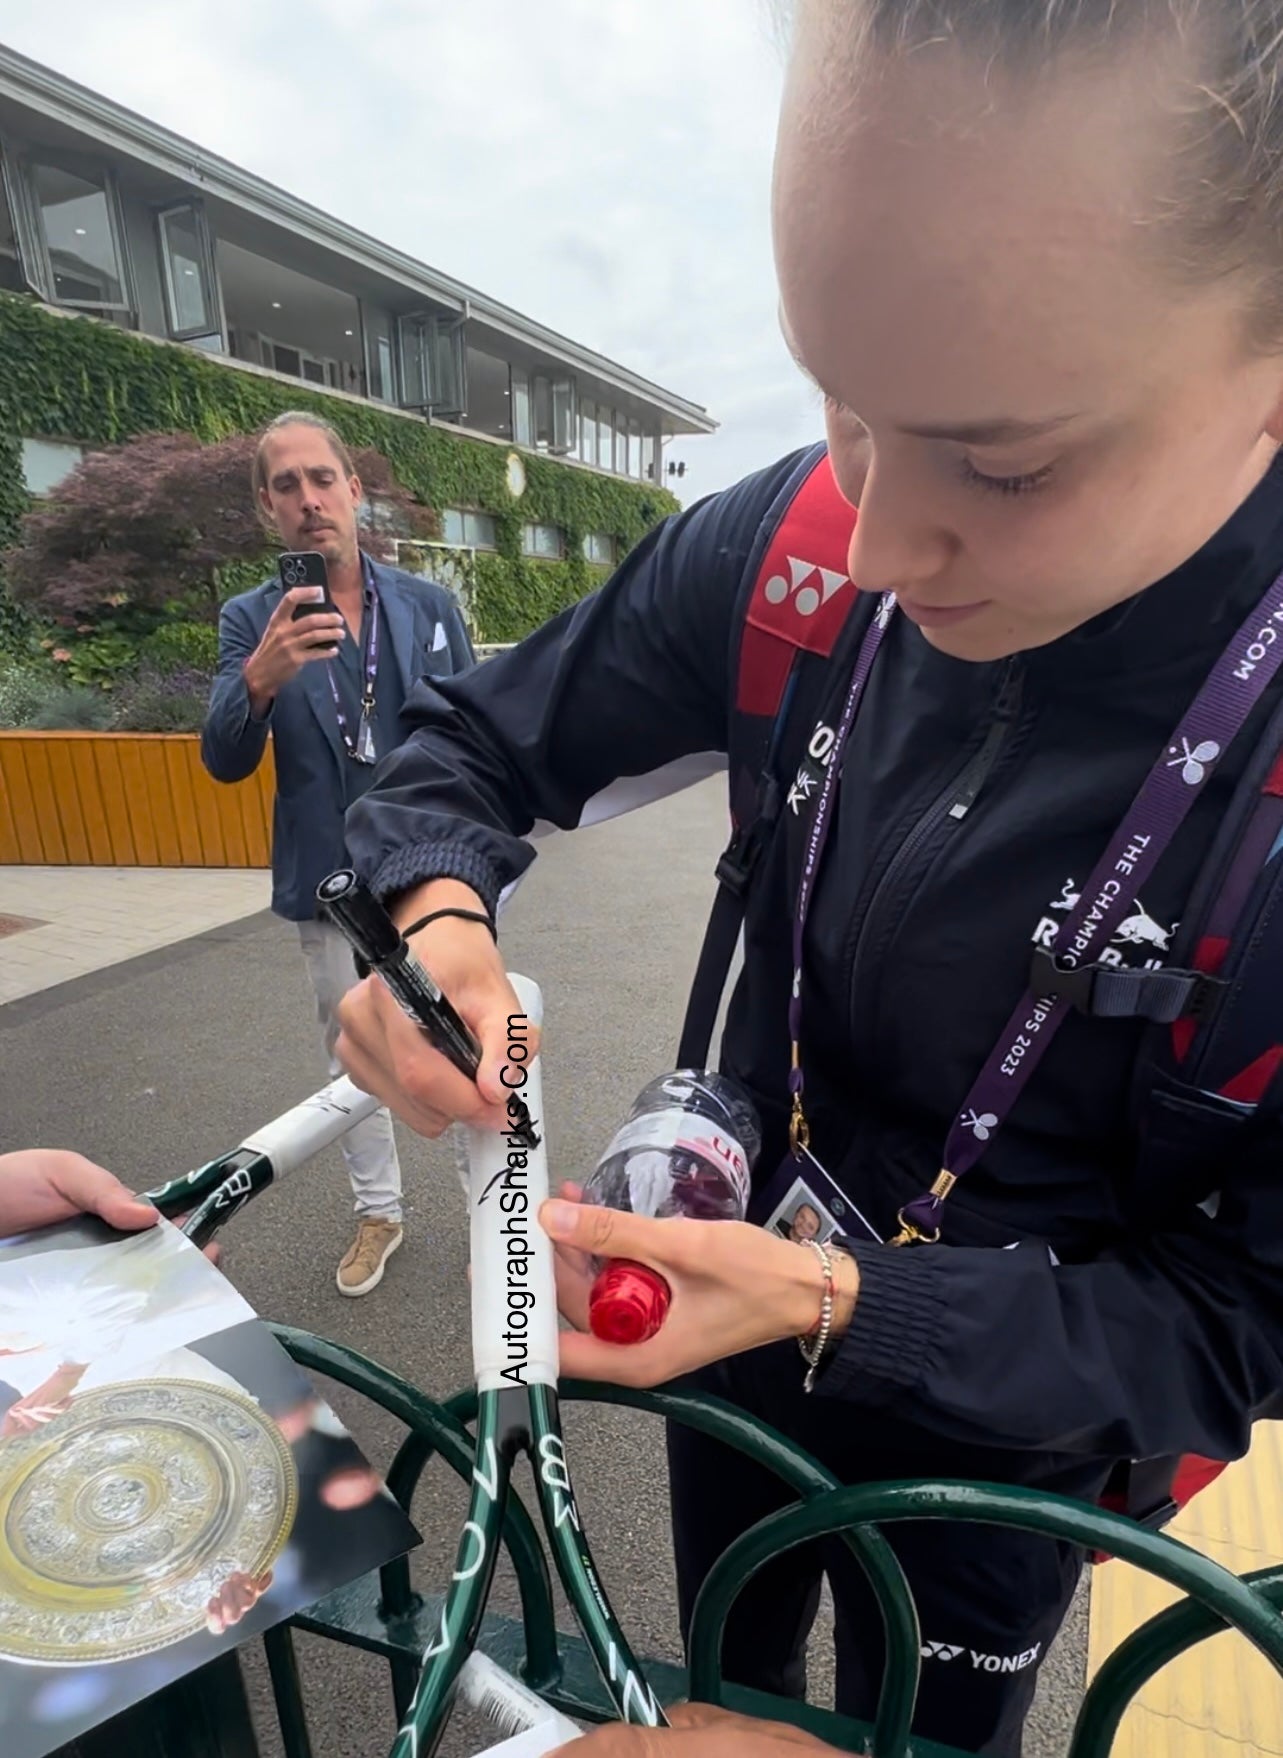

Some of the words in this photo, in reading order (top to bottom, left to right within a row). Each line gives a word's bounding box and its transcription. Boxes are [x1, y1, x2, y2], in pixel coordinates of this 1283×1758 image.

[1115, 834, 1151, 876] THE
[1000, 1034, 1032, 1077] 2023
[969, 1641, 1041, 1673] YONEX
